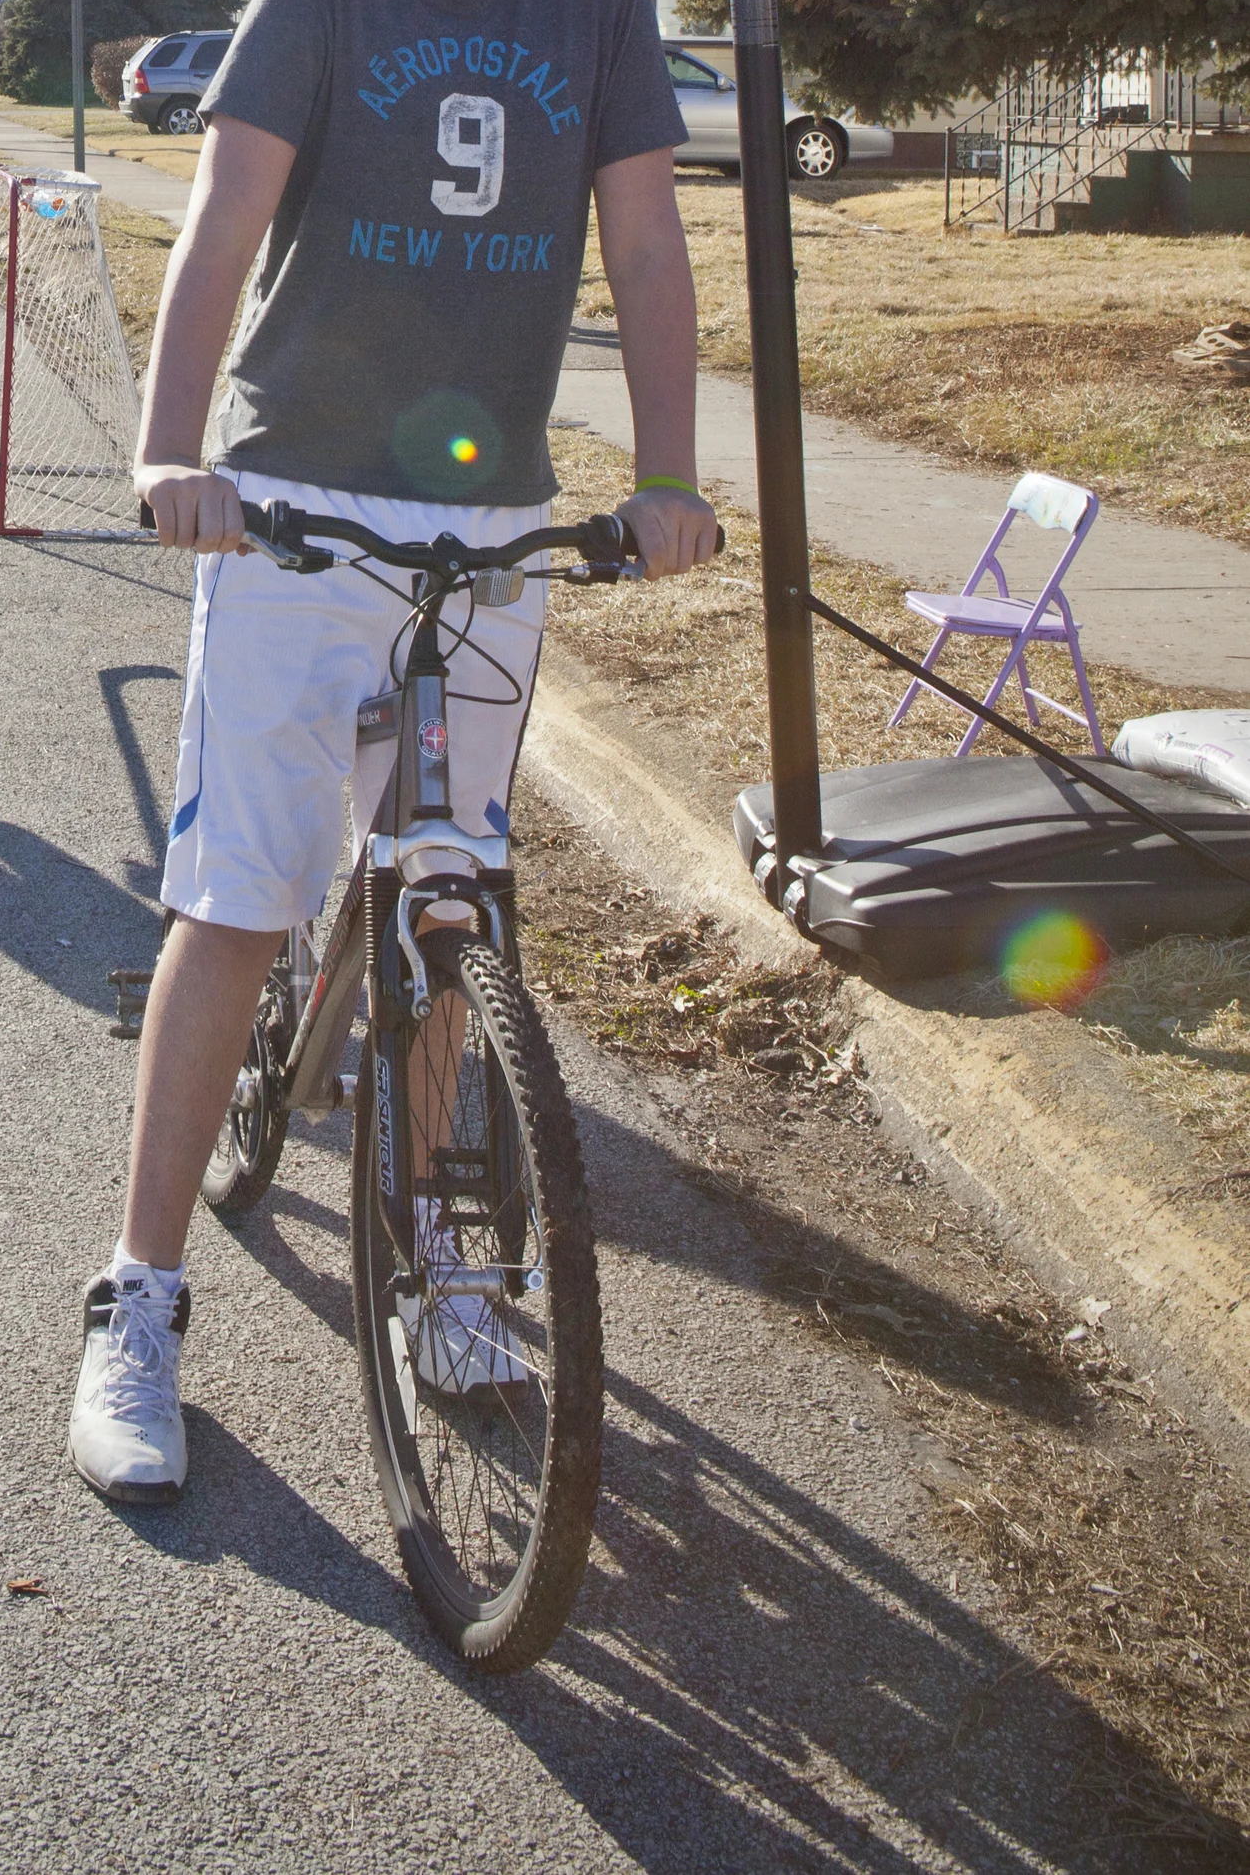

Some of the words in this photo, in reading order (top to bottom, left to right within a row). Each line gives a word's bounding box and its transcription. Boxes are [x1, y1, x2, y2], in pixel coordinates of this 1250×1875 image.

[430, 92, 505, 217] 9
[350, 218, 442, 267] NEW
[463, 232, 555, 272] YORK
[377, 1095, 394, 1195] SUNTOUR
[122, 1278, 145, 1292] NIKE
